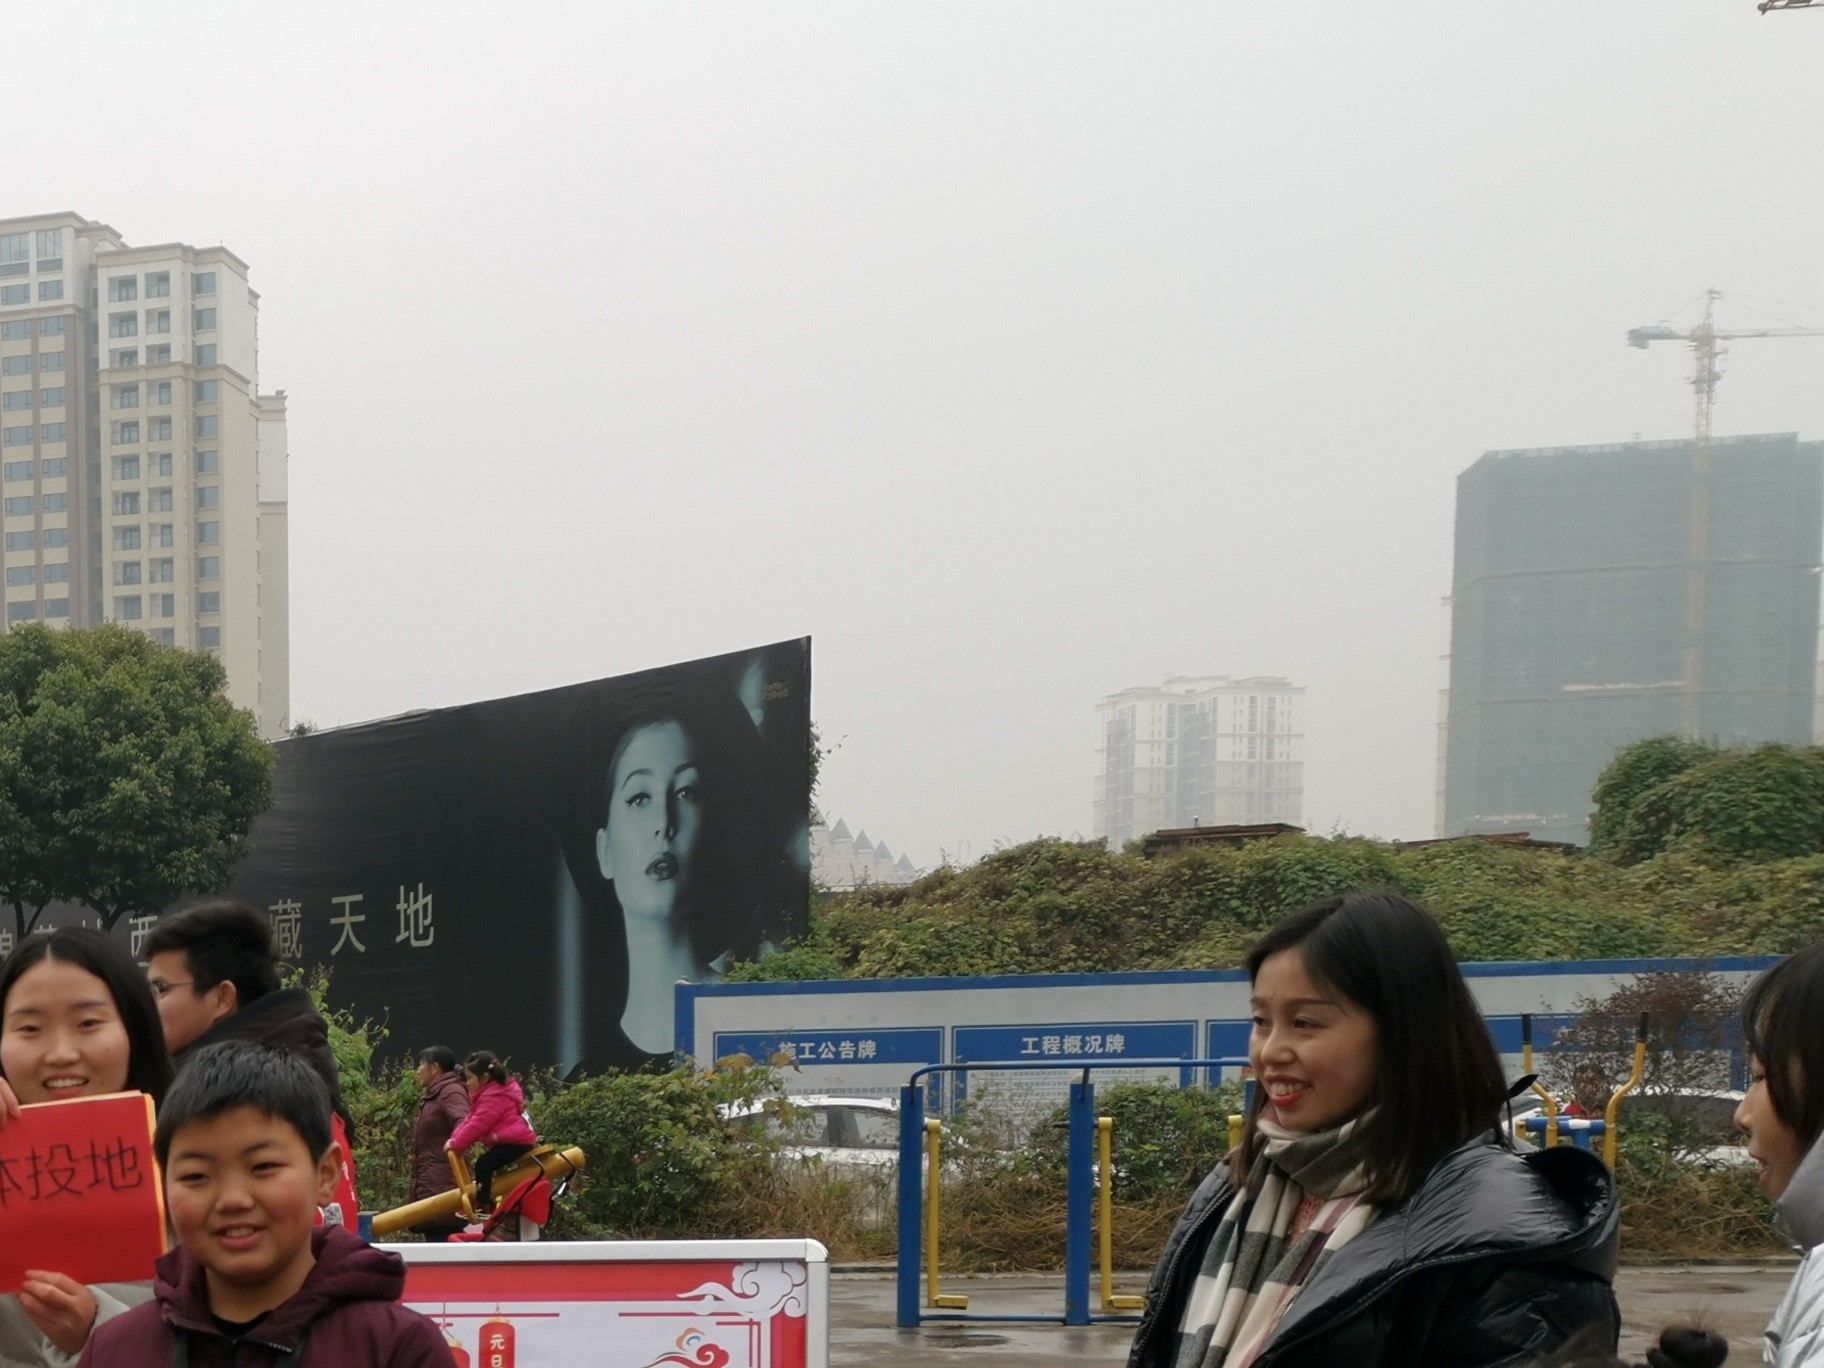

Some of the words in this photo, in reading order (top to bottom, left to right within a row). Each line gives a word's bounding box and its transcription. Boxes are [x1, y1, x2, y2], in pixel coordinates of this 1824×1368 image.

[778, 1039, 877, 1060] 施工公告牌
[1020, 1033, 1126, 1055] 工程概况牌
